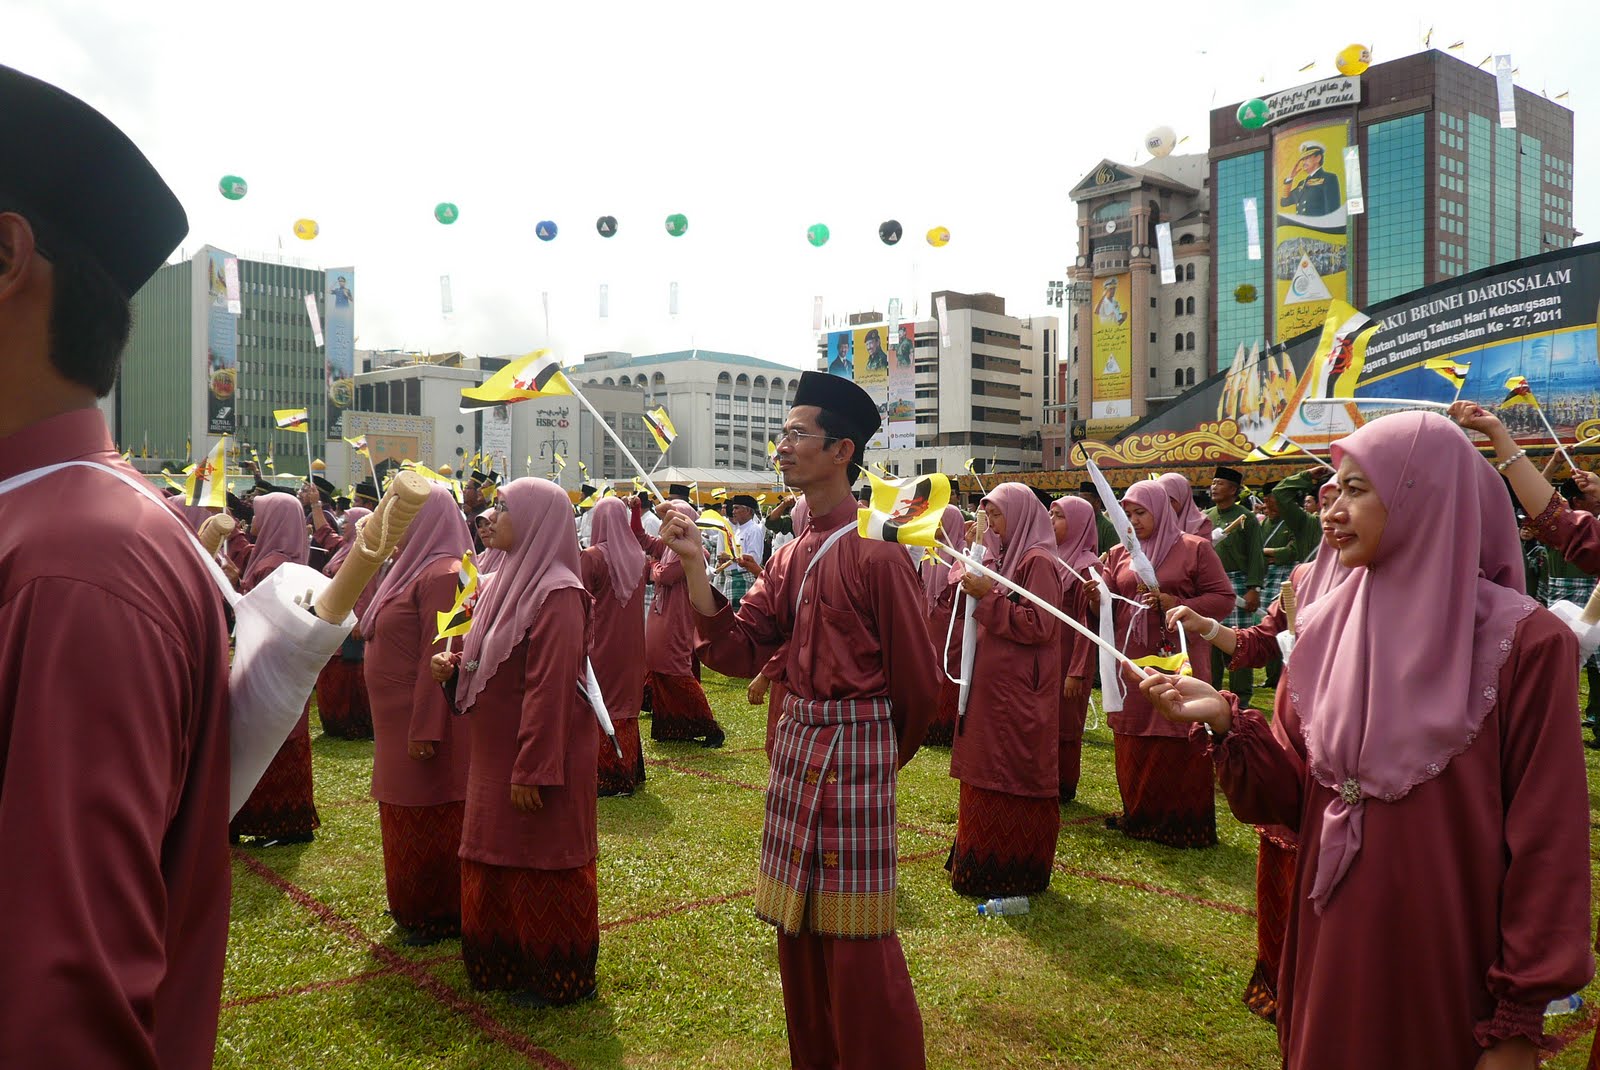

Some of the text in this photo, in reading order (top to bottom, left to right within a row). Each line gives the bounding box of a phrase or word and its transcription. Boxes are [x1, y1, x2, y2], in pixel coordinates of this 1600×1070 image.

[1325, 94, 1354, 104] UTAMA
[1397, 328, 1428, 345] Ulang
[1428, 316, 1462, 335] Tahun
[1464, 309, 1487, 324] Hari
[1489, 295, 1561, 318] Kebangsaan
[1410, 292, 1465, 322] BRUNEI
[1468, 268, 1572, 305] DARUSSALAM
[1388, 343, 1422, 363] Brunei
[1423, 327, 1485, 352] Darussalam
[1487, 321, 1504, 334] Ke
[1512, 315, 1531, 328] 27,
[1533, 308, 1562, 324] 2011
[536, 418, 557, 427] HSBC
